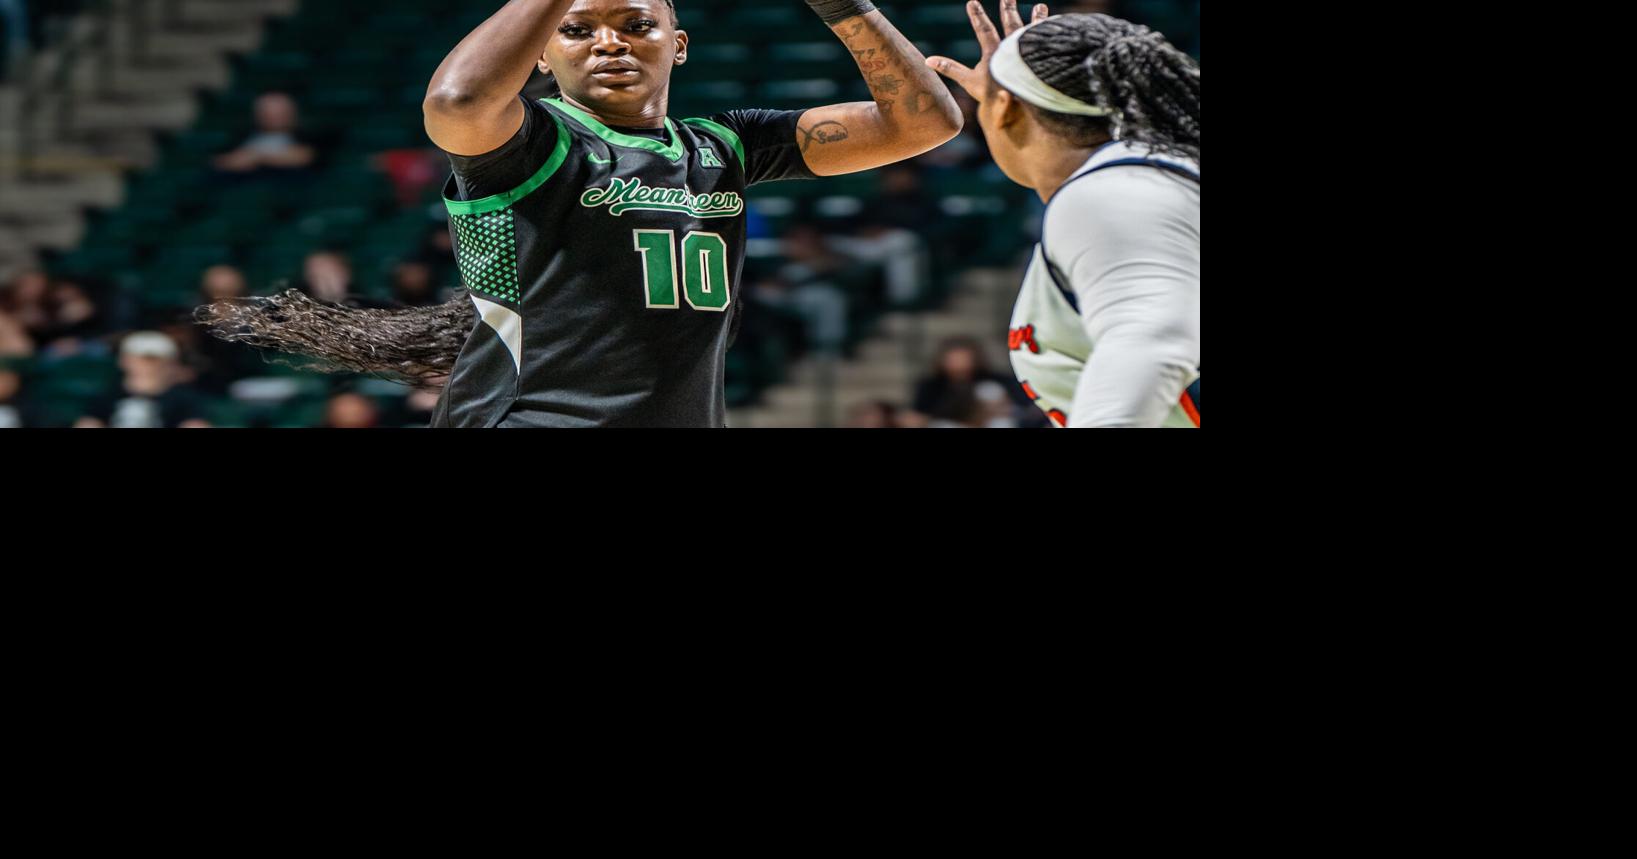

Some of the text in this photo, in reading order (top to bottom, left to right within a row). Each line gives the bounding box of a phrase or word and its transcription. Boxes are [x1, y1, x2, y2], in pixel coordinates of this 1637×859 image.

[698, 147, 726, 169] A
[580, 177, 744, 217] Mean reen
[632, 229, 731, 312] 10
